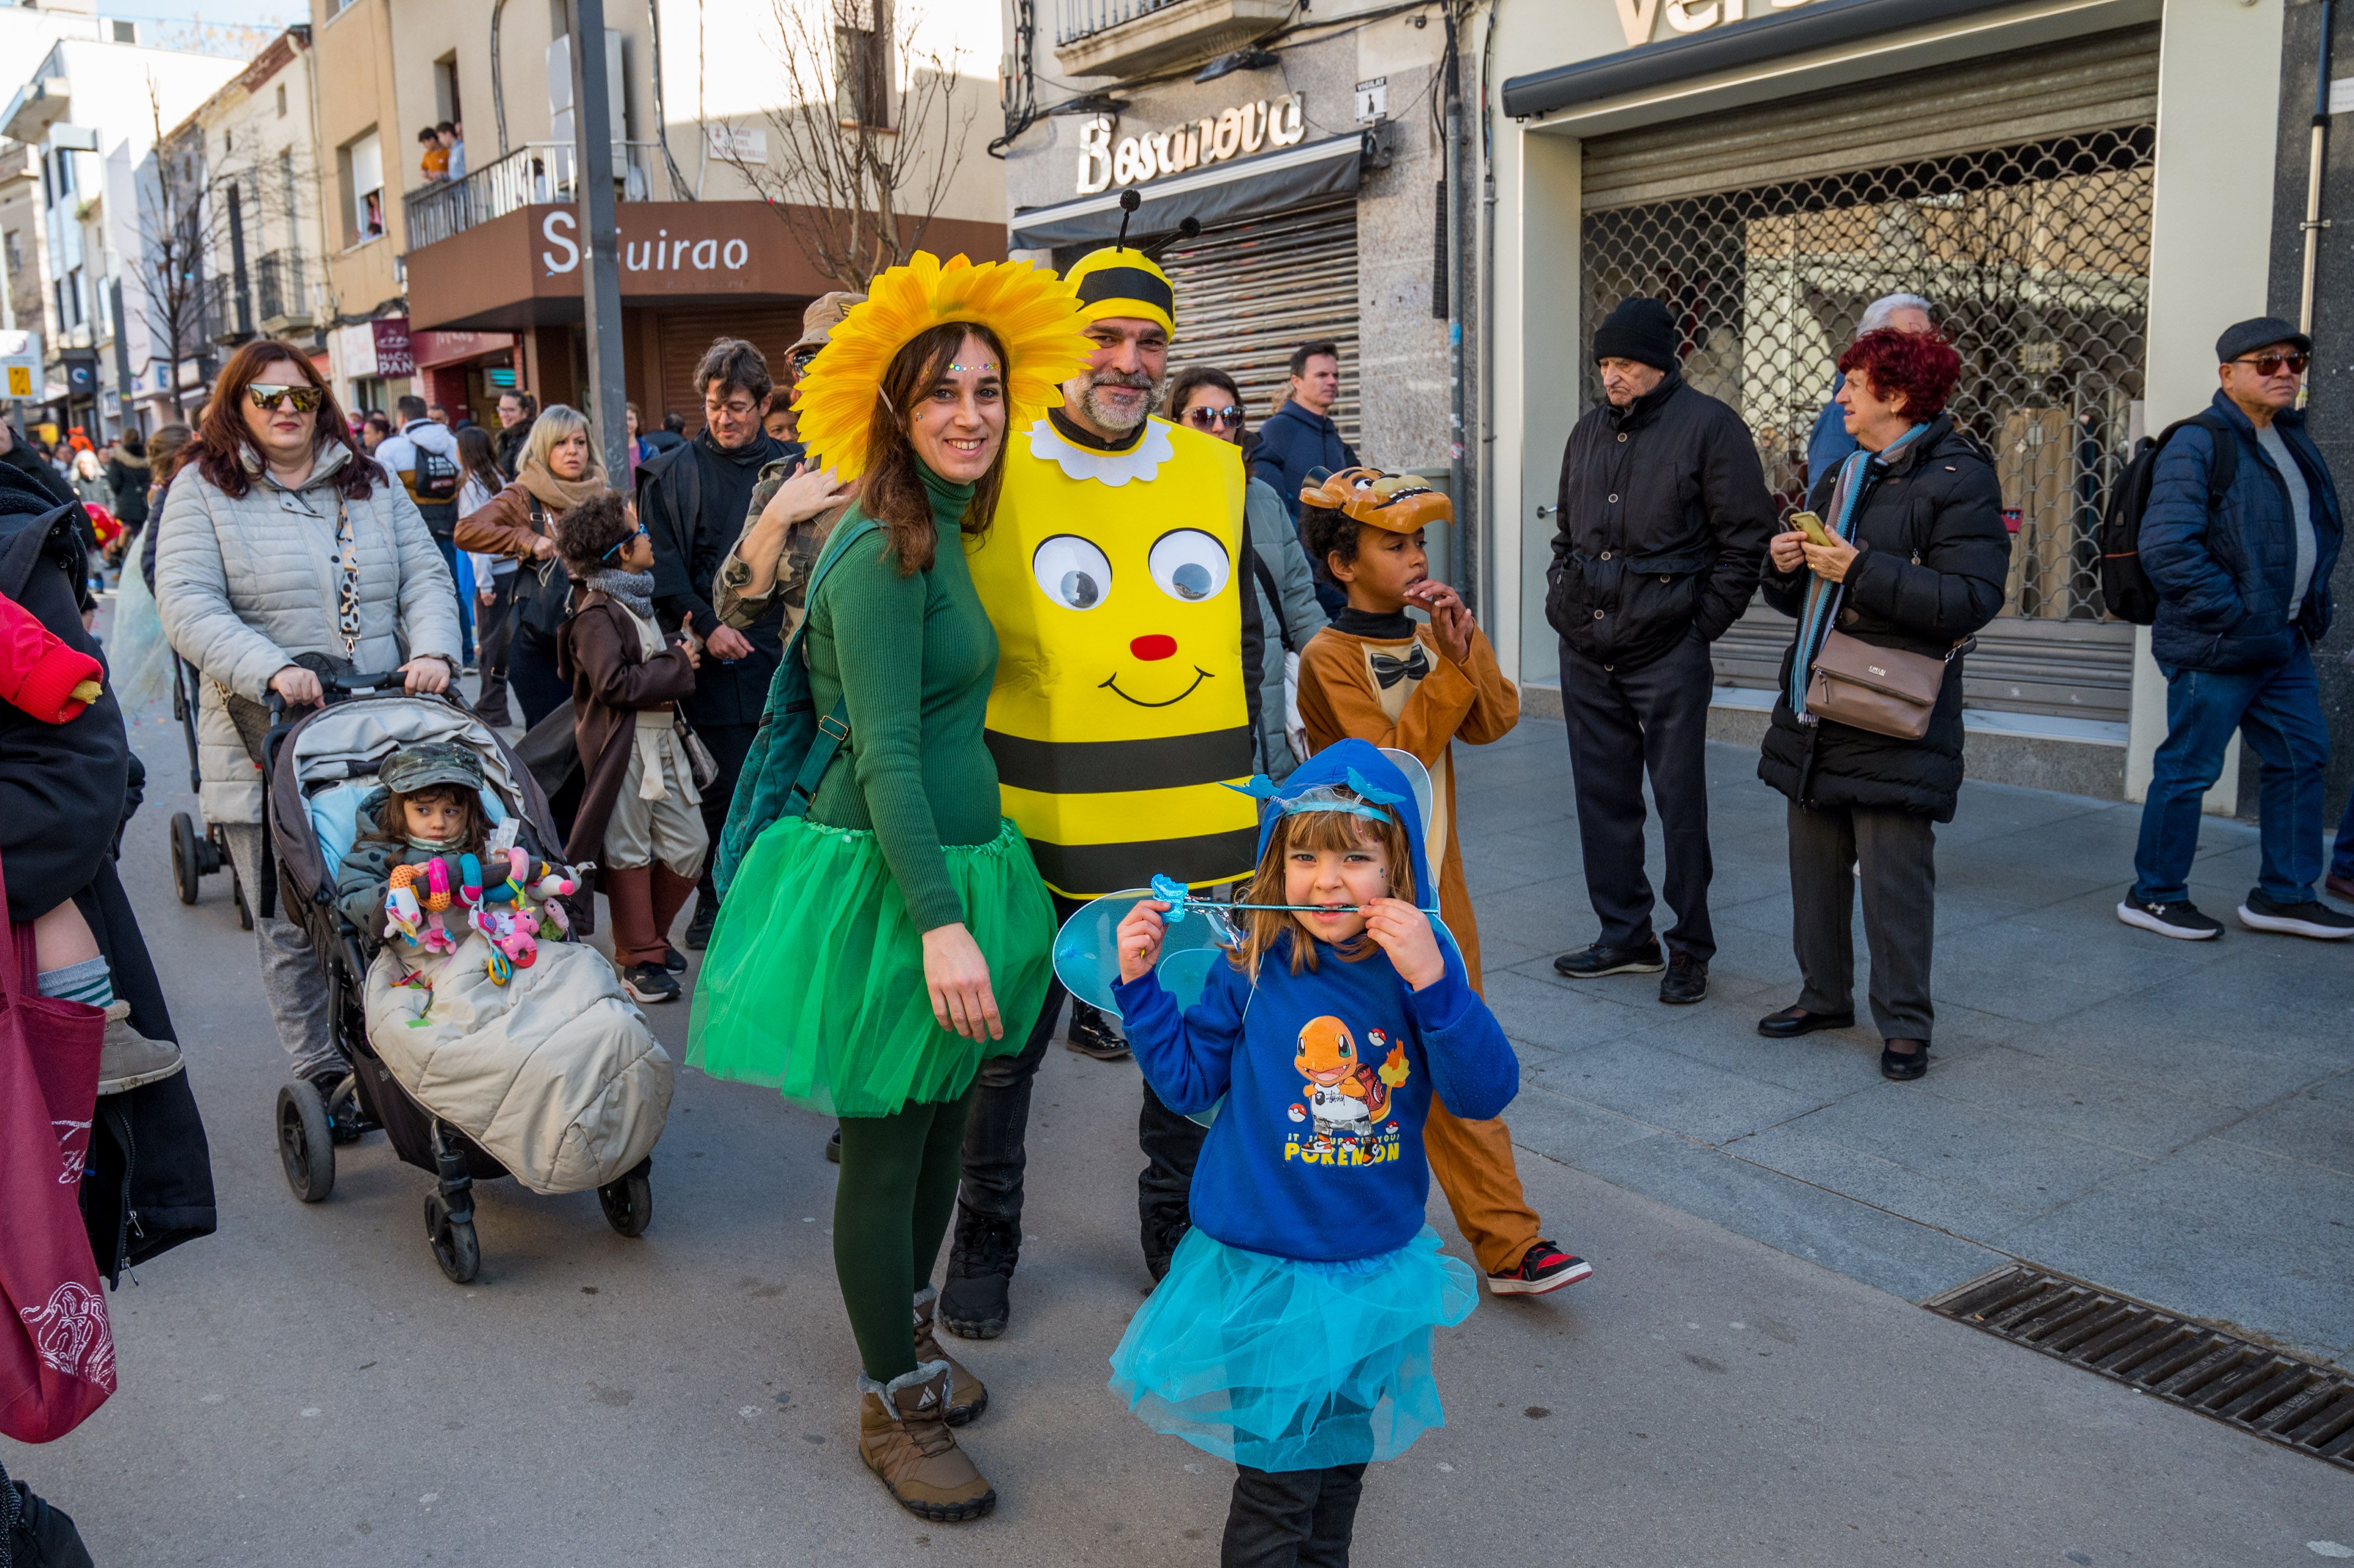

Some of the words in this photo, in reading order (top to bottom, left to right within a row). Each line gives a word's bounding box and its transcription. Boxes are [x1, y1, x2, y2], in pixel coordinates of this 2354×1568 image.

[616, 227, 748, 271] uirao
[378, 359, 414, 375] PAN
[1330, 1137, 1343, 1145] UP
[1377, 1133, 1400, 1143] YOU!
